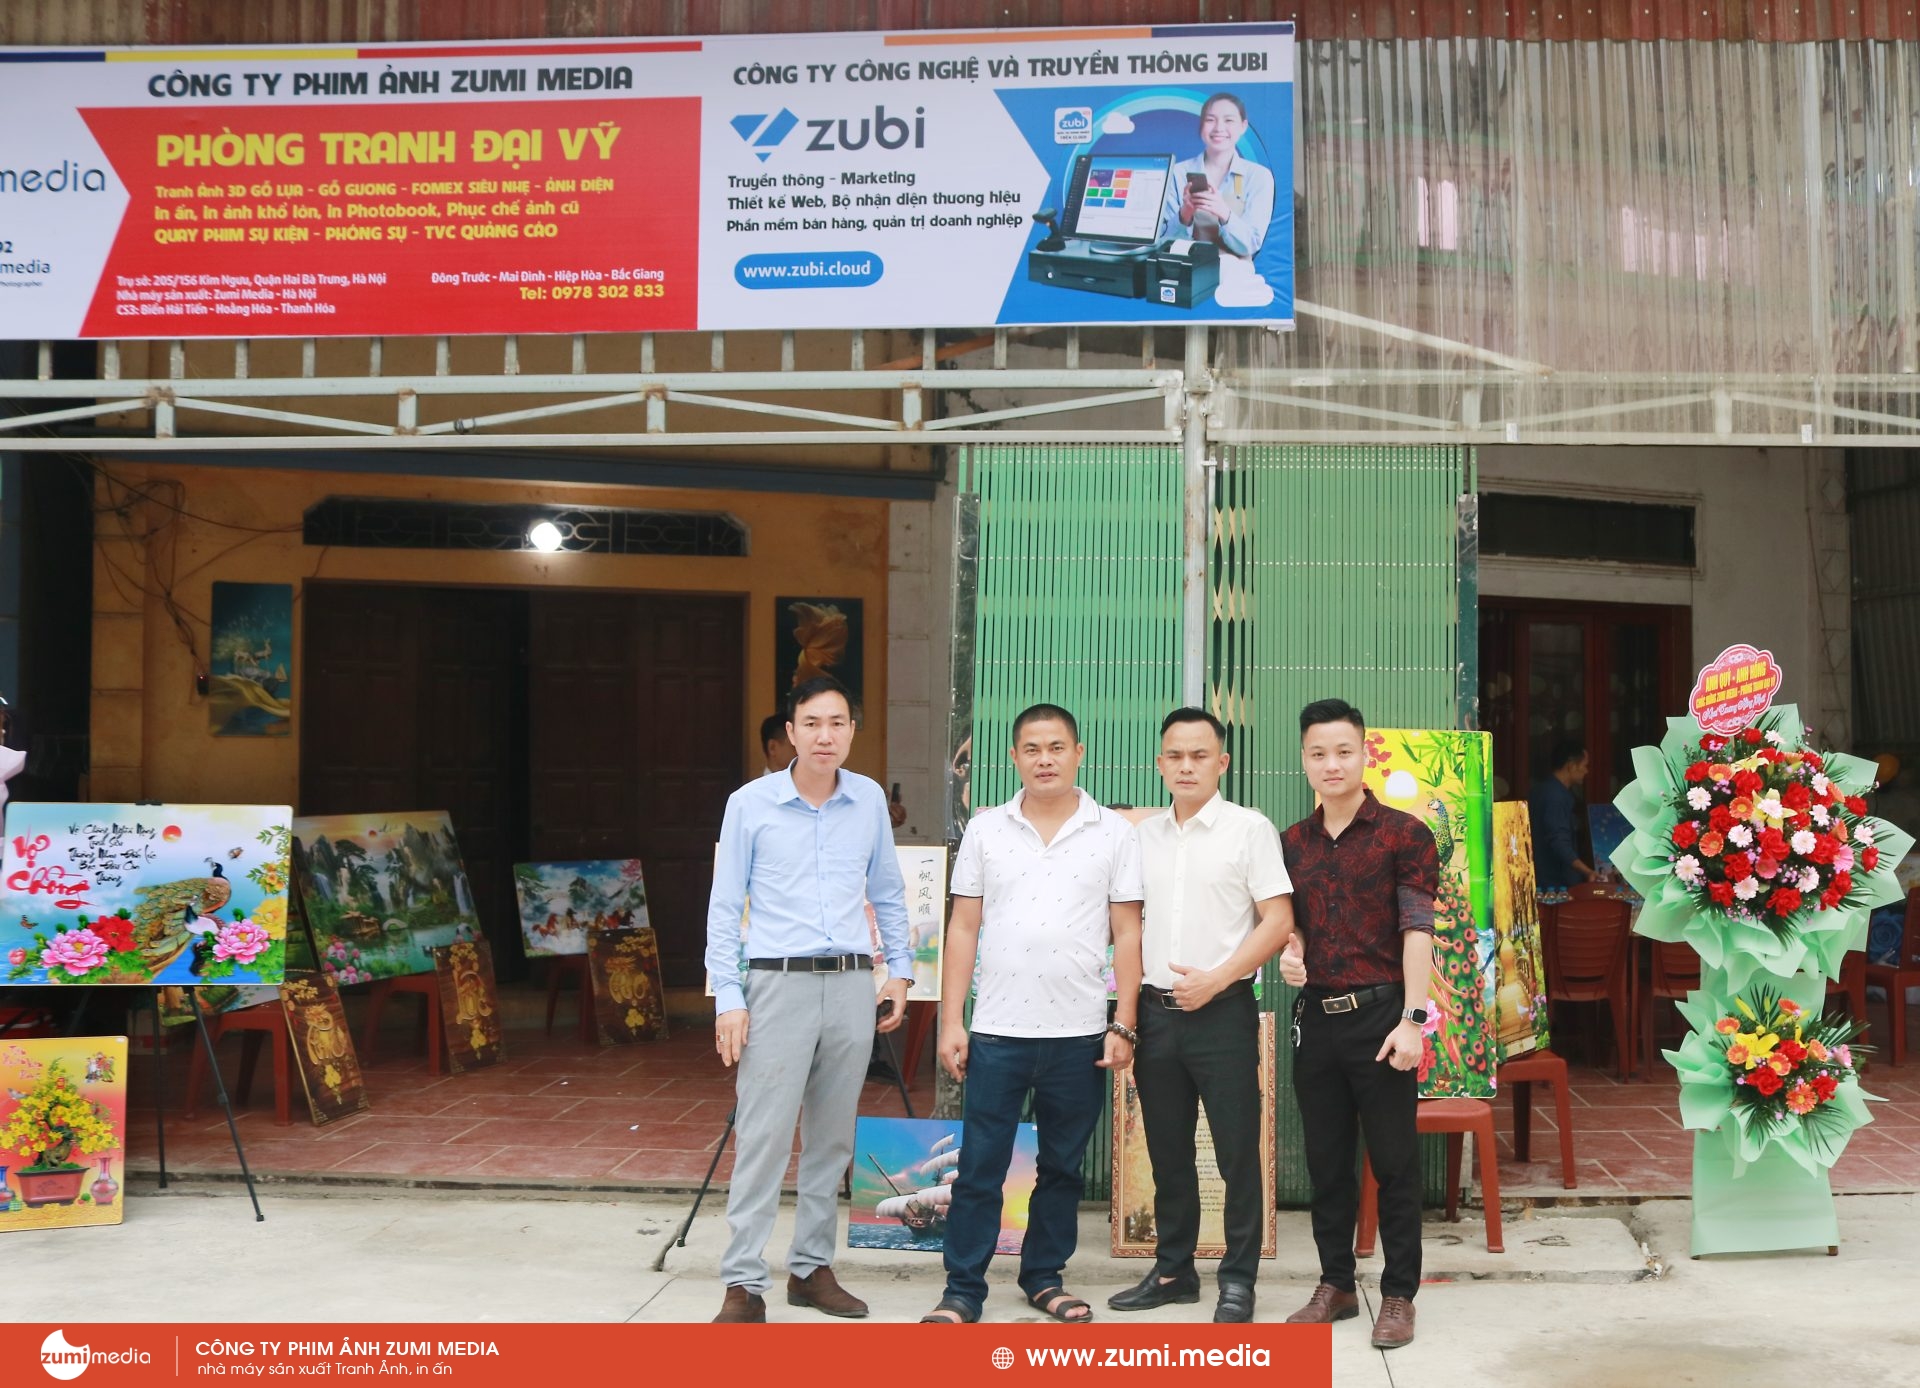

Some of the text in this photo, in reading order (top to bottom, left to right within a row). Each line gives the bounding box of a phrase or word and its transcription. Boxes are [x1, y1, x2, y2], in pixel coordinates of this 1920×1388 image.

[733, 50, 1268, 85] CÔNG TY CÔNG NGHỆ VÀ TRUYỀN THÔNG ZUBI
[148, 64, 633, 97] CÔNG TY PHIM ẢNH ZUMI MEDIA
[805, 105, 925, 151] zubi
[157, 121, 621, 170] PHÒNG TRANH ĐẠI VỸ
[155, 186, 193, 198] Tranh
[197, 182, 223, 198] Ảnh
[227, 184, 246, 197] 3D
[412, 181, 463, 195] FOMEX
[468, 179, 498, 194] SIÊU
[502, 180, 530, 196] NHẸ
[545, 177, 576, 192] ẢNH
[782, 174, 824, 189] thông
[841, 171, 915, 186] Marketing
[223, 204, 252, 219] ảnh
[328, 204, 342, 218] in
[347, 202, 441, 218] Photobook,
[447, 202, 486, 219] Phục
[491, 199, 521, 216] chế
[525, 200, 555, 215] ảnh
[561, 200, 579, 214] cũ
[728, 195, 763, 210] Thiết
[768, 194, 786, 209] kế
[792, 195, 826, 208] Web,
[832, 194, 851, 210] Bộ
[856, 193, 890, 209] nhận
[896, 192, 927, 208] diện
[989, 190, 1020, 206] hiệu
[802, 218, 827, 230] bán
[832, 217, 867, 231] hàng,
[872, 215, 906, 231] quản
[911, 215, 925, 229] trị
[929, 214, 972, 227] doanh
[976, 213, 1023, 229] nghiệp
[155, 228, 198, 244] QUAY
[203, 227, 244, 242] PHIM
[274, 225, 308, 244] KIỆN
[425, 225, 456, 239] TVC
[461, 221, 519, 240] QUẢNG
[431, 272, 459, 285] Đông
[499, 271, 519, 282] Mai
[554, 270, 578, 283] Hiệp
[580, 269, 602, 281] Hòa
[632, 268, 664, 282] Giang
[743, 260, 871, 278] www.zubi.cloud
[153, 275, 197, 287] 205/156
[198, 275, 220, 286] Kim
[283, 274, 300, 285] Hai
[302, 274, 316, 285] Bà
[352, 273, 367, 284] Hà
[368, 273, 387, 286] Nội
[214, 288, 240, 300] Zumi
[241, 288, 274, 300] Media
[282, 288, 297, 299] Hà
[298, 288, 317, 301] Nội
[520, 284, 664, 300] Tel: 0978 302 833
[280, 302, 313, 314] Thanh
